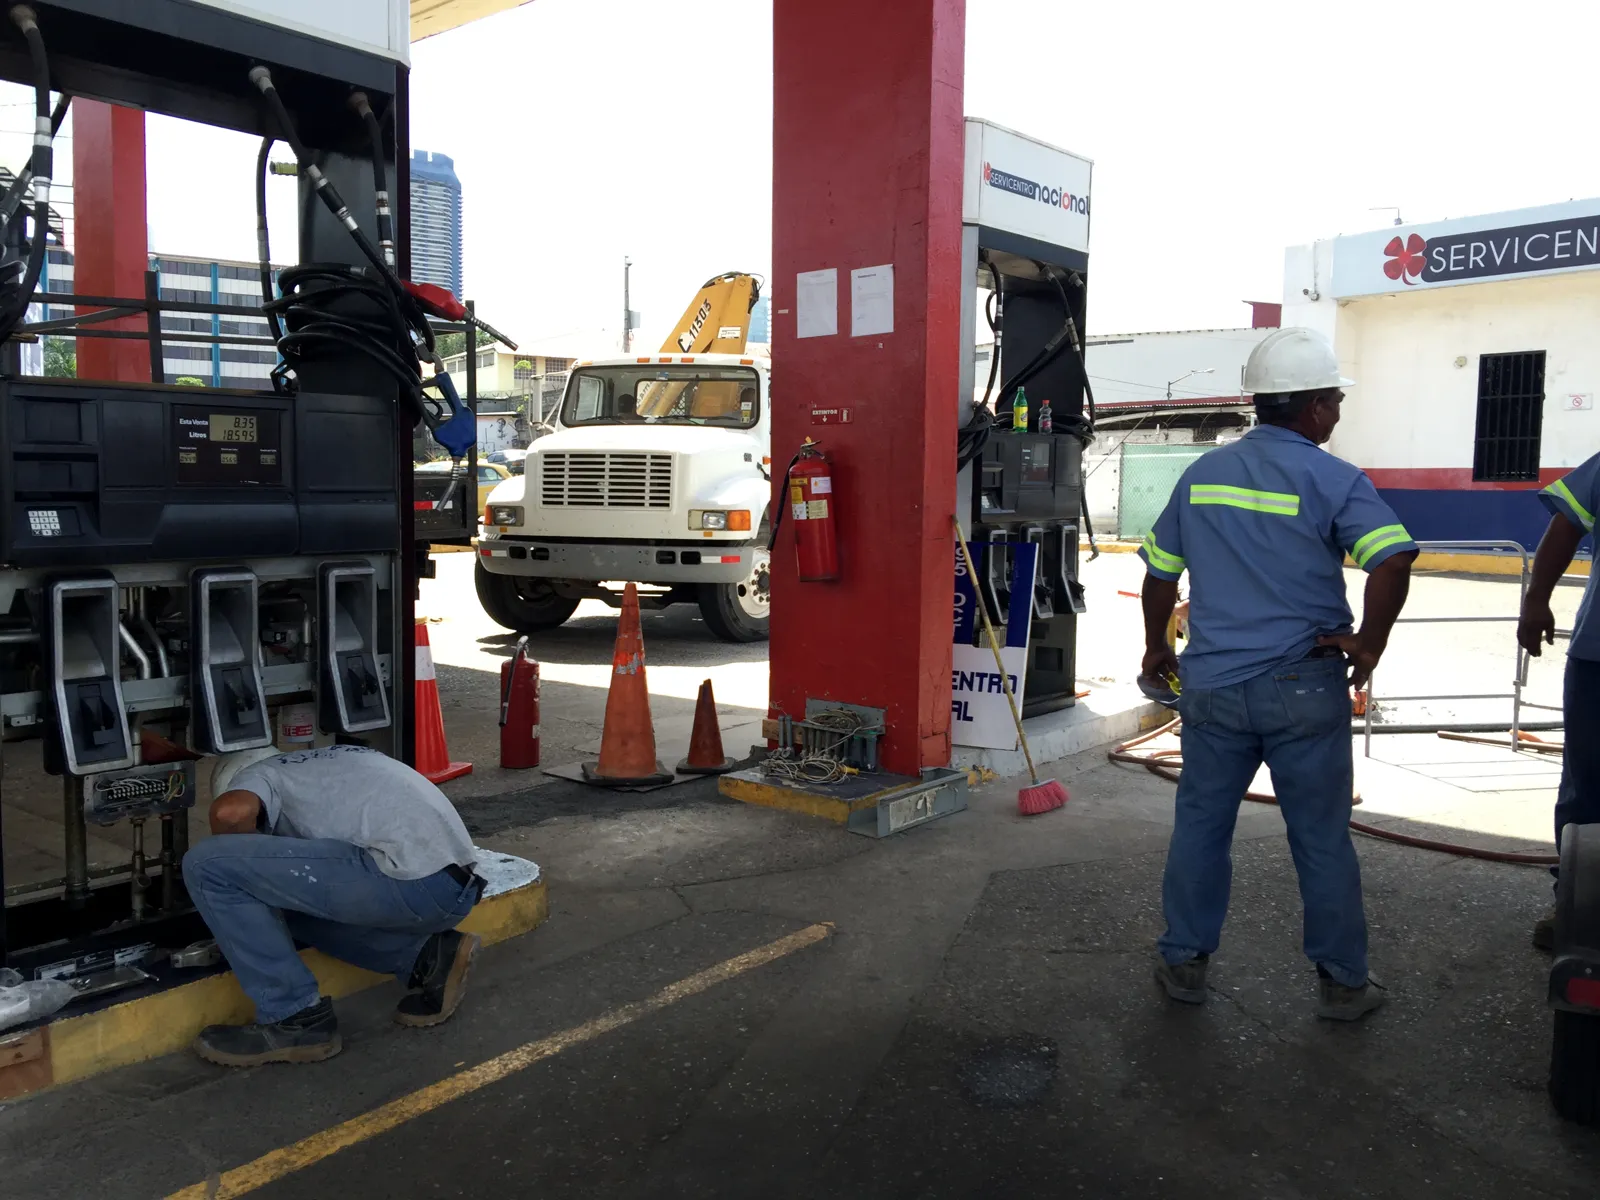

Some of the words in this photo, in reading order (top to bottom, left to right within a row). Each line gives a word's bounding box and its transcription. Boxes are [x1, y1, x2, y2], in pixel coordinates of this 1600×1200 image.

[990, 171, 1034, 196] SERVICENTRO
[1035, 184, 1090, 216] nacional
[1429, 226, 1598, 273] SERVICEN
